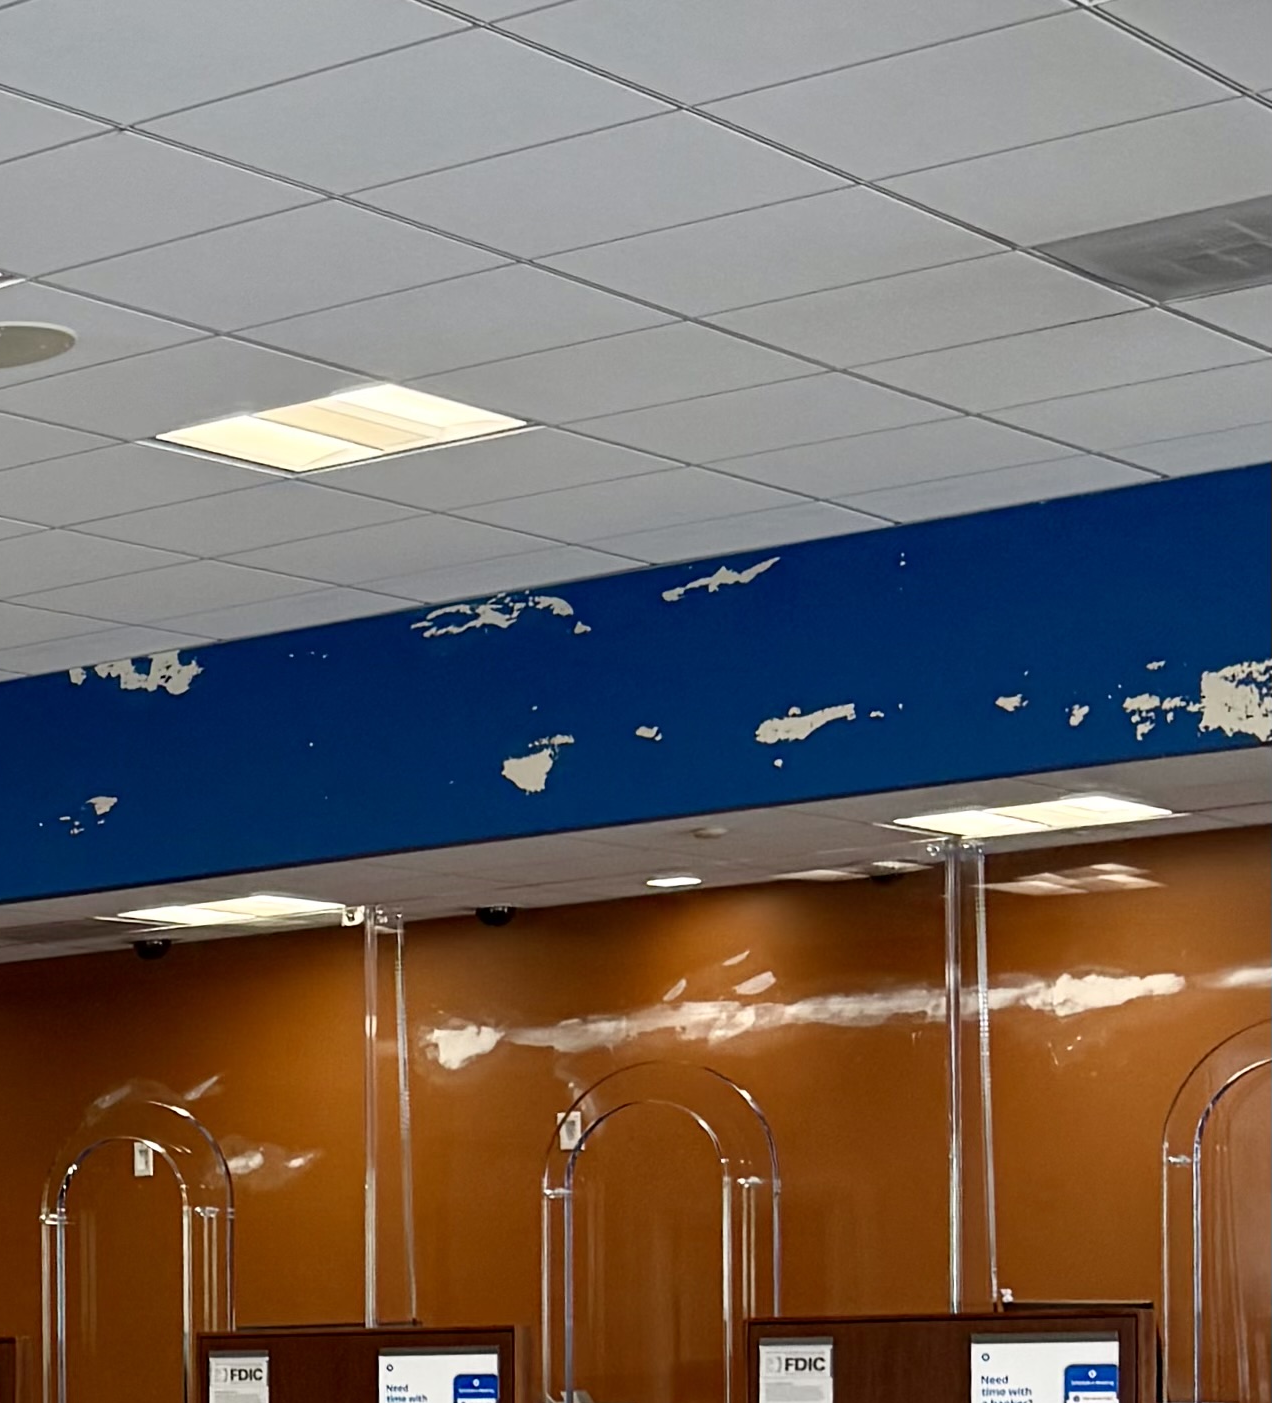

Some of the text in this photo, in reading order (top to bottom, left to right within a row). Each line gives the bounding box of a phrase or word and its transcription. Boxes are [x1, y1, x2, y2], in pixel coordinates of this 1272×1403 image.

[784, 1357, 826, 1372] FDIC
[230, 1368, 263, 1381] FDIC
[981, 1375, 1009, 1385] Need
[386, 1385, 409, 1393] Need
[981, 1388, 1033, 1397] time with
[409, 1395, 428, 1403] with
